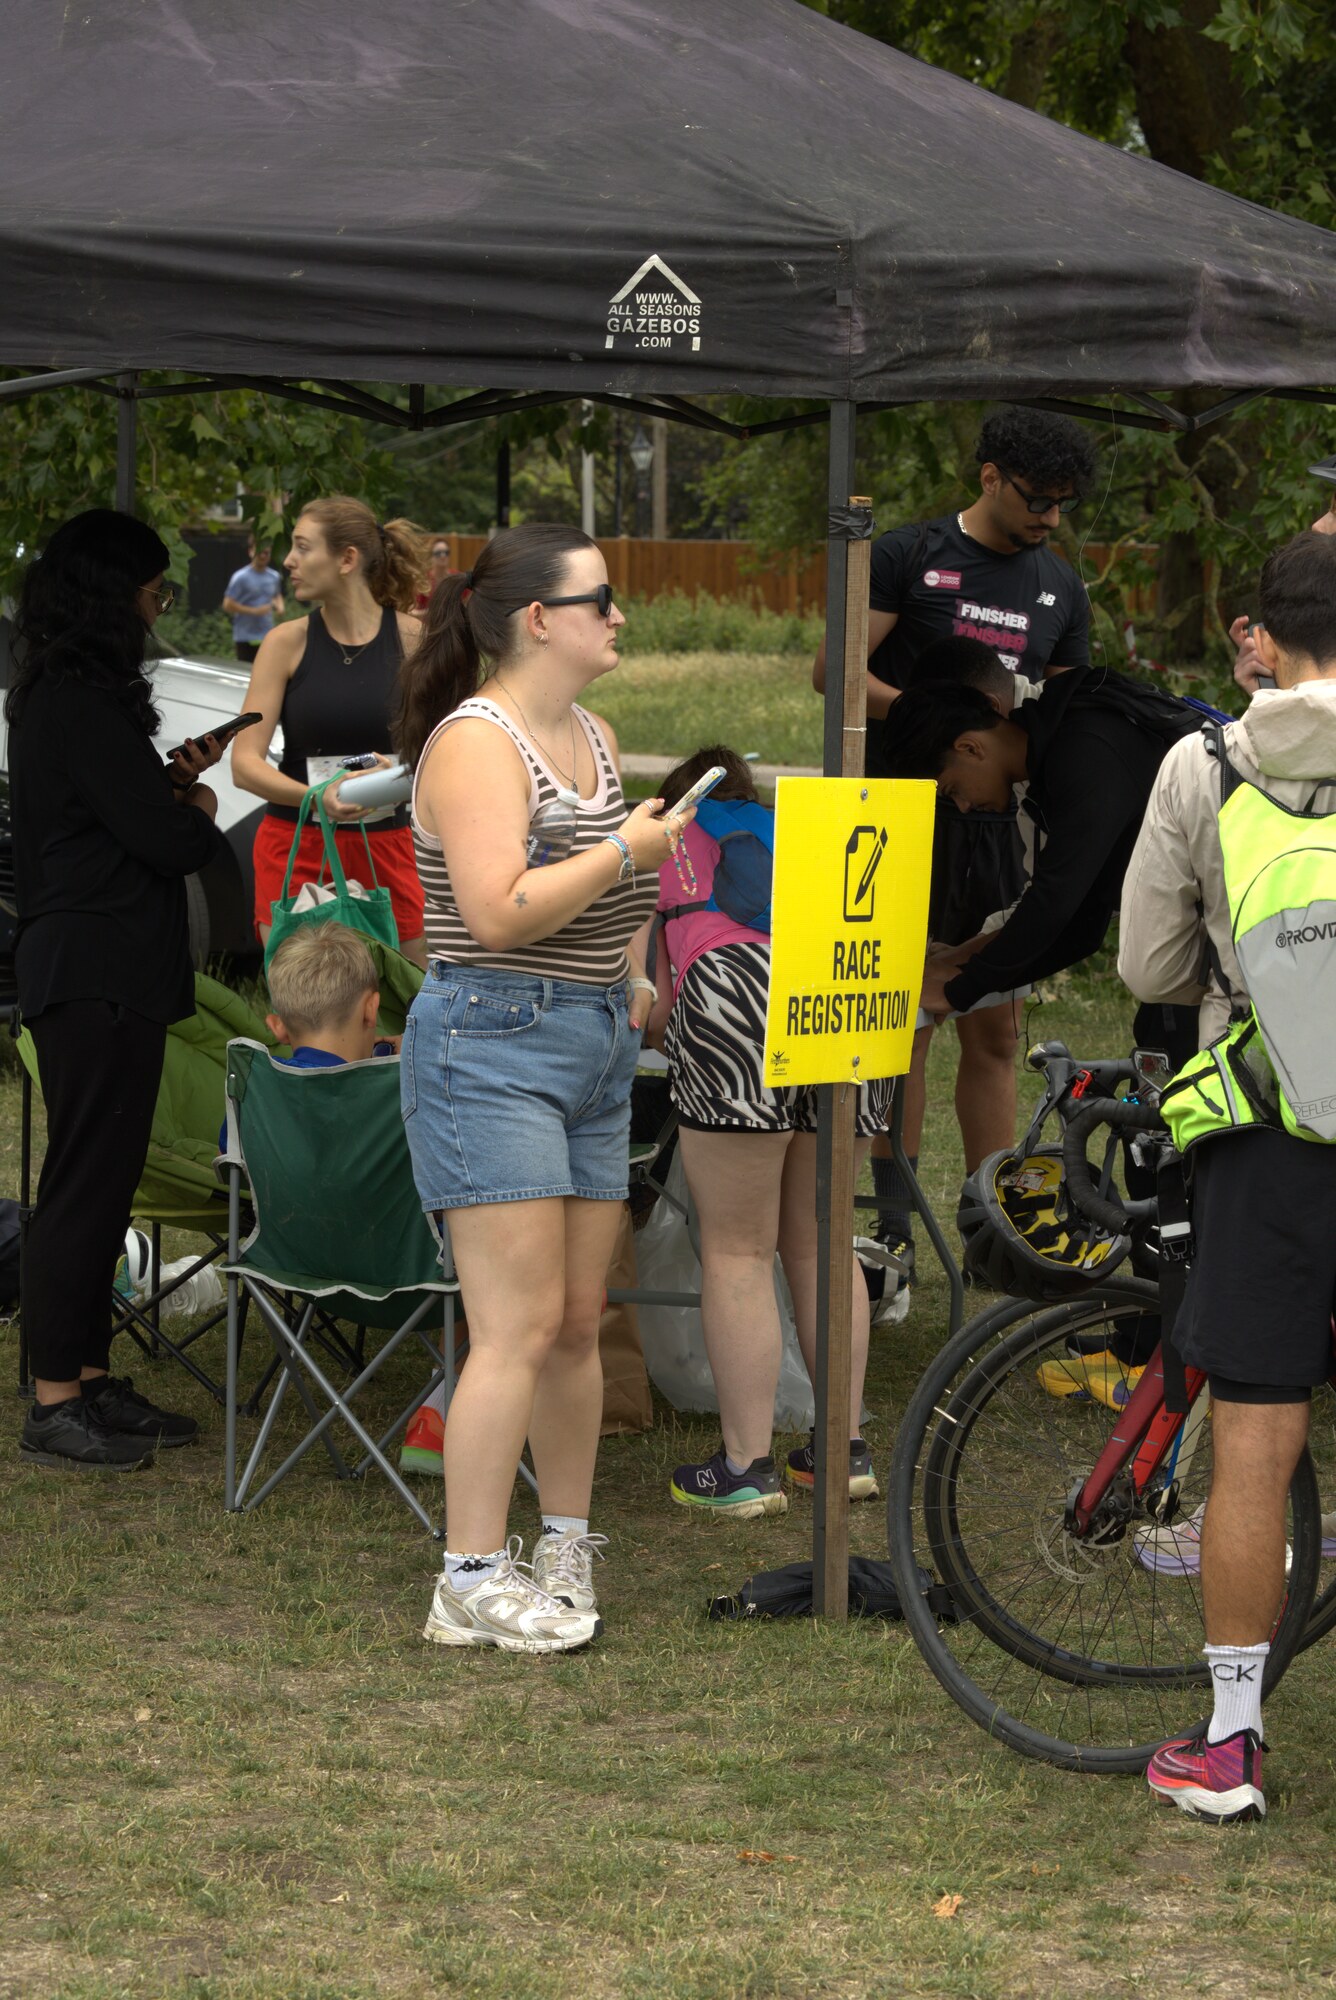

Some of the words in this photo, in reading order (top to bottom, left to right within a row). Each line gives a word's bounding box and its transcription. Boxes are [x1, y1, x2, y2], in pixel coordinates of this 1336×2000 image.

[608, 305, 633, 315] ALL
[639, 304, 701, 316] SEASONS
[606, 317, 700, 334] GAZEBOS
[635, 336, 672, 348] .COM
[961, 603, 1028, 630] FINISHER
[957, 623, 1026, 651] FINISHER
[832, 940, 881, 981] RACE
[786, 990, 910, 1037] REGISTRATION
[1213, 1663, 1258, 1683] CK
